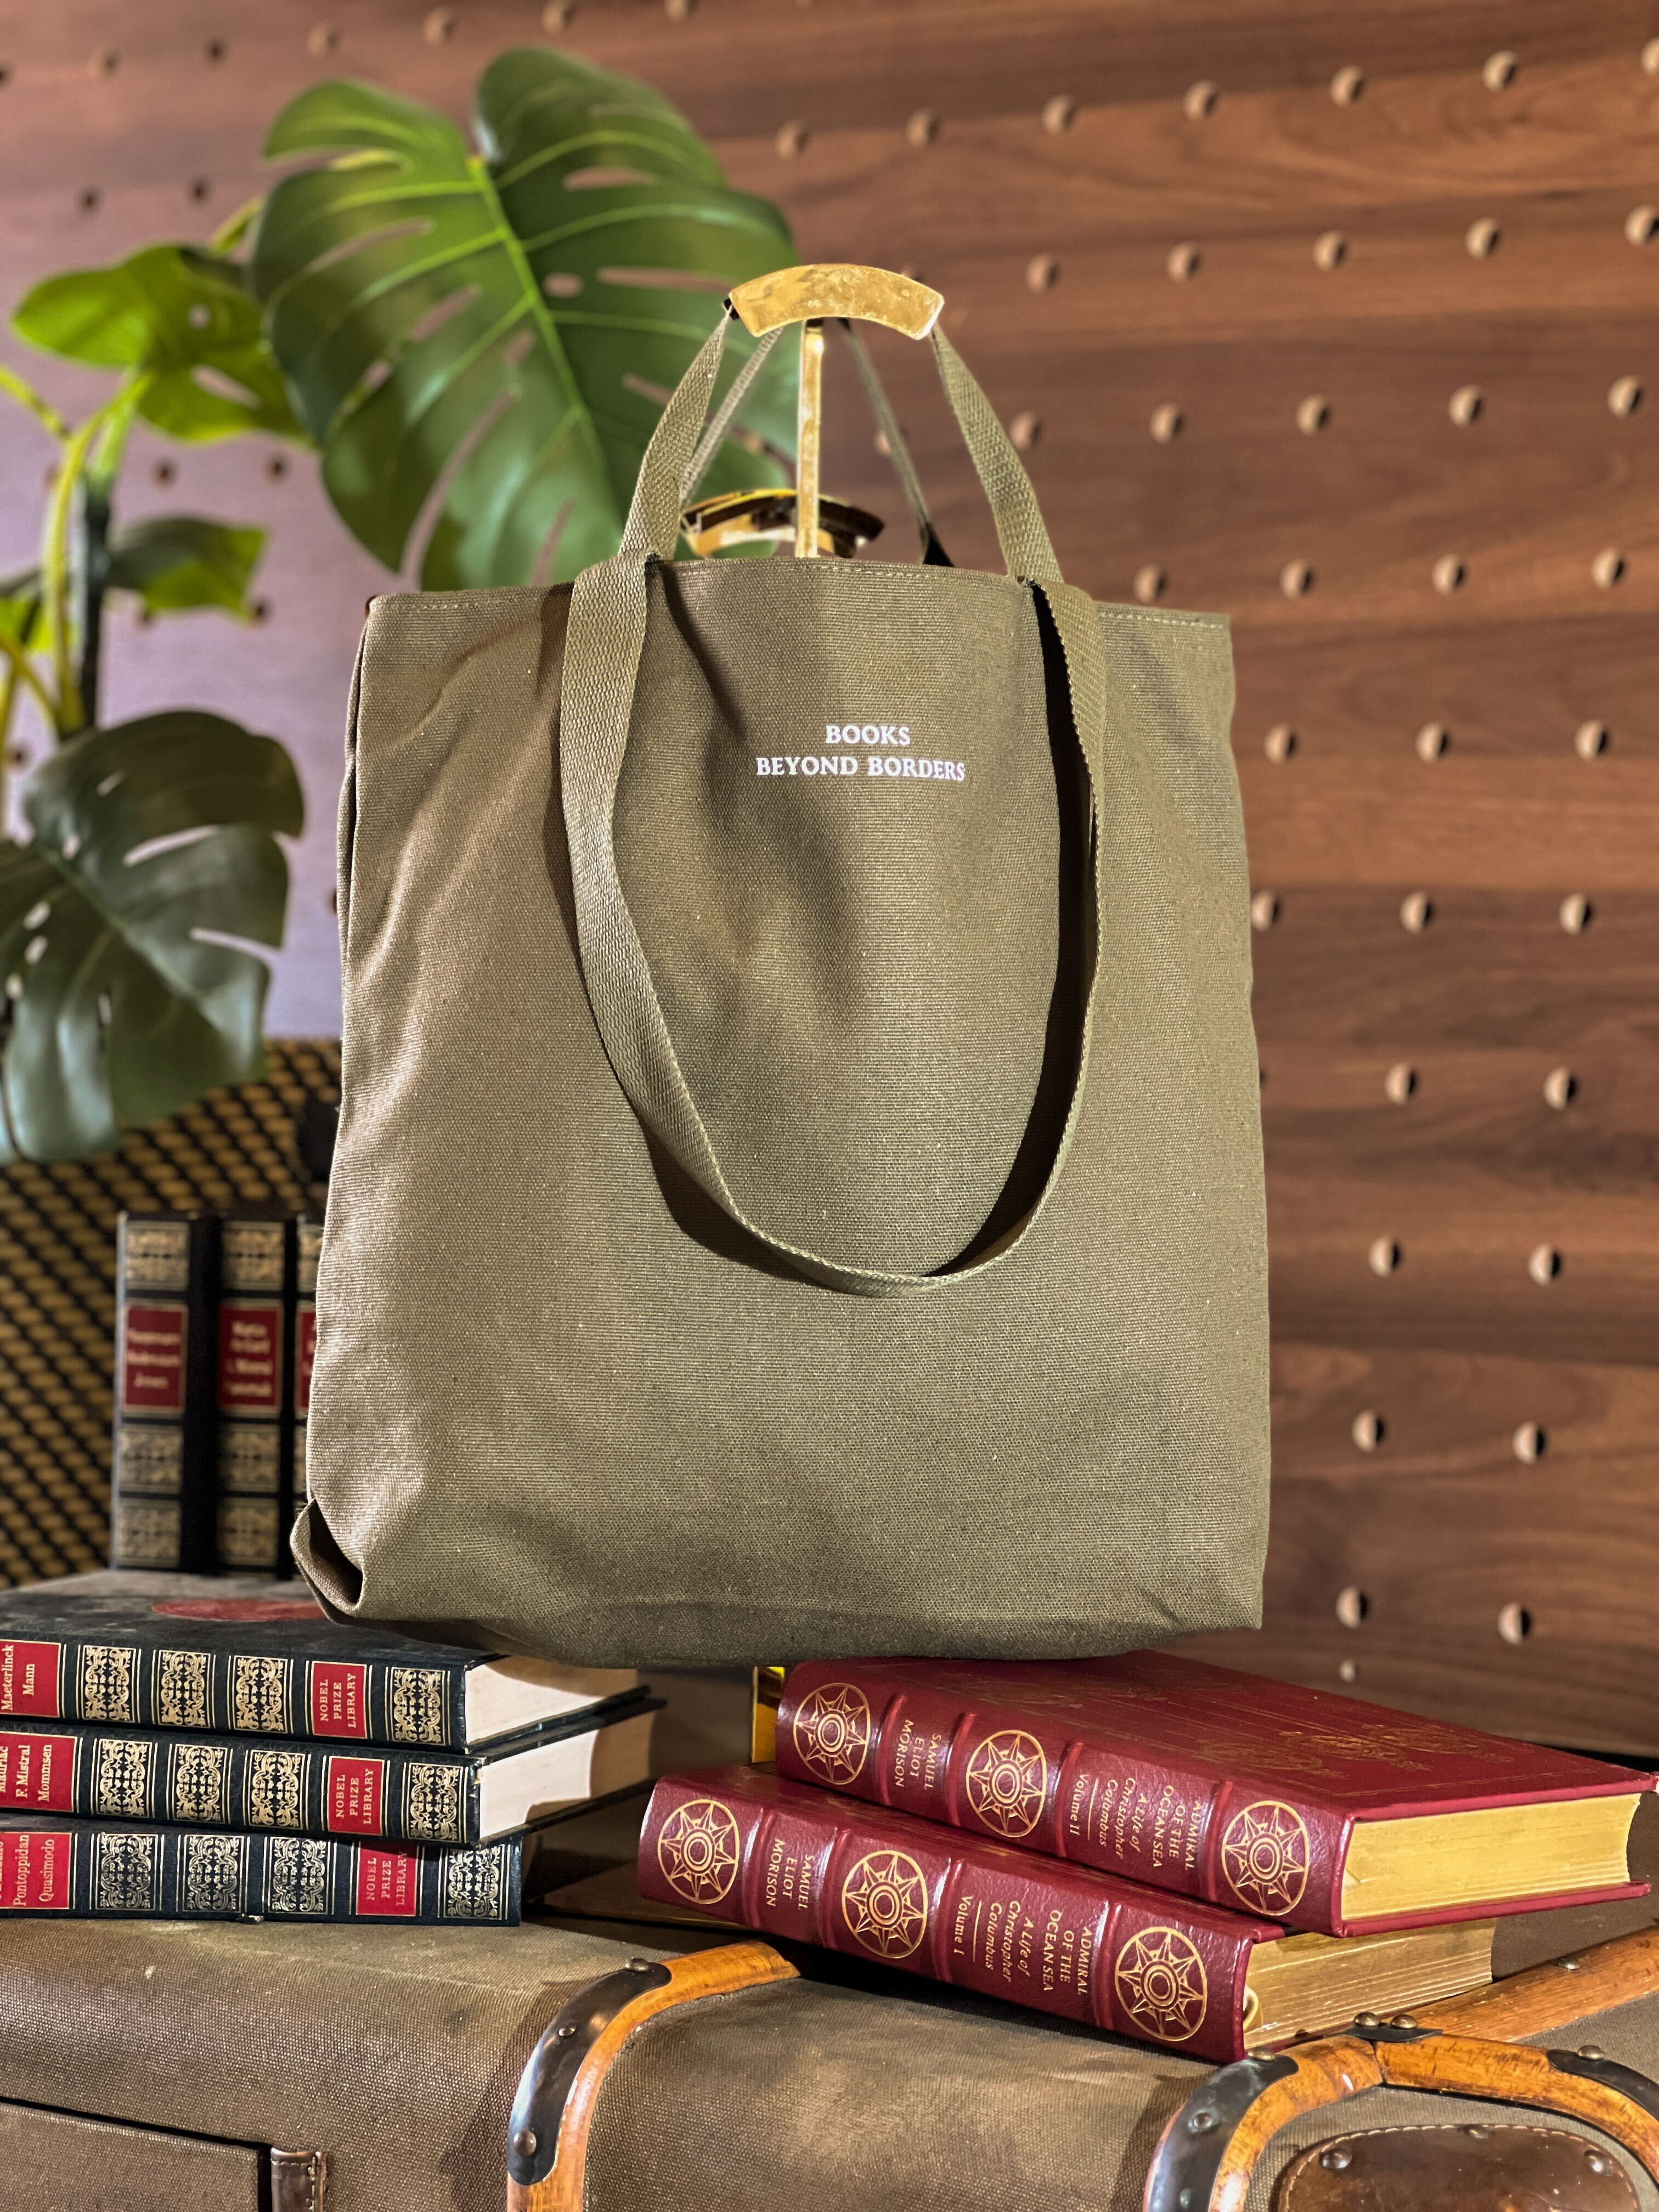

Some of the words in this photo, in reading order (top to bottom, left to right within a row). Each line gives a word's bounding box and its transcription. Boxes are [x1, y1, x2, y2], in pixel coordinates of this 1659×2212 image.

[825, 725, 911, 745] BOOKS
[756, 757, 858, 776] BEYOND
[867, 757, 966, 781] BORDERS
[1, 1645, 14, 1711] Maeterlinck
[22, 1663, 35, 1696] Mann
[320, 1679, 329, 1722] NOBEL
[334, 1682, 342, 1720] PRIZE
[347, 1673, 357, 1728] LIBRARY
[16, 1745, 31, 1786] Mistral
[38, 1744, 52, 1802] Mommsen
[895, 1719, 914, 1787] MORISON
[910, 1736, 925, 1779] ELIOT
[924, 1733, 942, 1790] SAMUEL
[16, 1788, 28, 1798] F.
[336, 1774, 345, 1818] NOBEL
[349, 1777, 359, 1816] PRIZE
[363, 1768, 374, 1825] LIBRARY
[1070, 1774, 1090, 1822] Volume
[1099, 1779, 1119, 1847] Columbus
[1137, 1793, 1148, 1803] A
[1154, 1785, 1174, 1838] OCEAN
[1070, 1824, 1080, 1836] II
[1114, 1777, 1136, 1860] Christopher
[1131, 1806, 1146, 1834] Life
[1171, 1805, 1186, 1826] OF
[1185, 1800, 1204, 1871] ADMIRAL
[1130, 1835, 1142, 1853] of
[1153, 1841, 1164, 1867] SEA
[1169, 1828, 1182, 1859] THE
[13, 1835, 30, 1906] Pontoppidan
[39, 1839, 55, 1902] Quasimodo
[366, 1857, 377, 1900] NOBEL
[381, 1860, 392, 1899] PRIZE
[396, 1850, 408, 1906] LIBRARY
[766, 1838, 786, 1907] MORISON
[782, 1857, 798, 1899] ELIOT
[798, 1854, 815, 1910] SAMUEL
[954, 1895, 974, 1943] Volume
[985, 1902, 1002, 1970] Columbus
[1023, 1917, 1034, 1928] A
[1043, 1910, 1063, 1963] OCEAN
[1061, 1930, 1075, 1951] OF
[953, 1948, 965, 1956] I
[1001, 1900, 1021, 1982] Christopher
[1018, 1931, 1034, 1958] Life
[1077, 1926, 1092, 1995] ADMIRAL
[1017, 1960, 1031, 1977] of
[1043, 1965, 1054, 1991] SEA
[1060, 1954, 1073, 1983] THE
